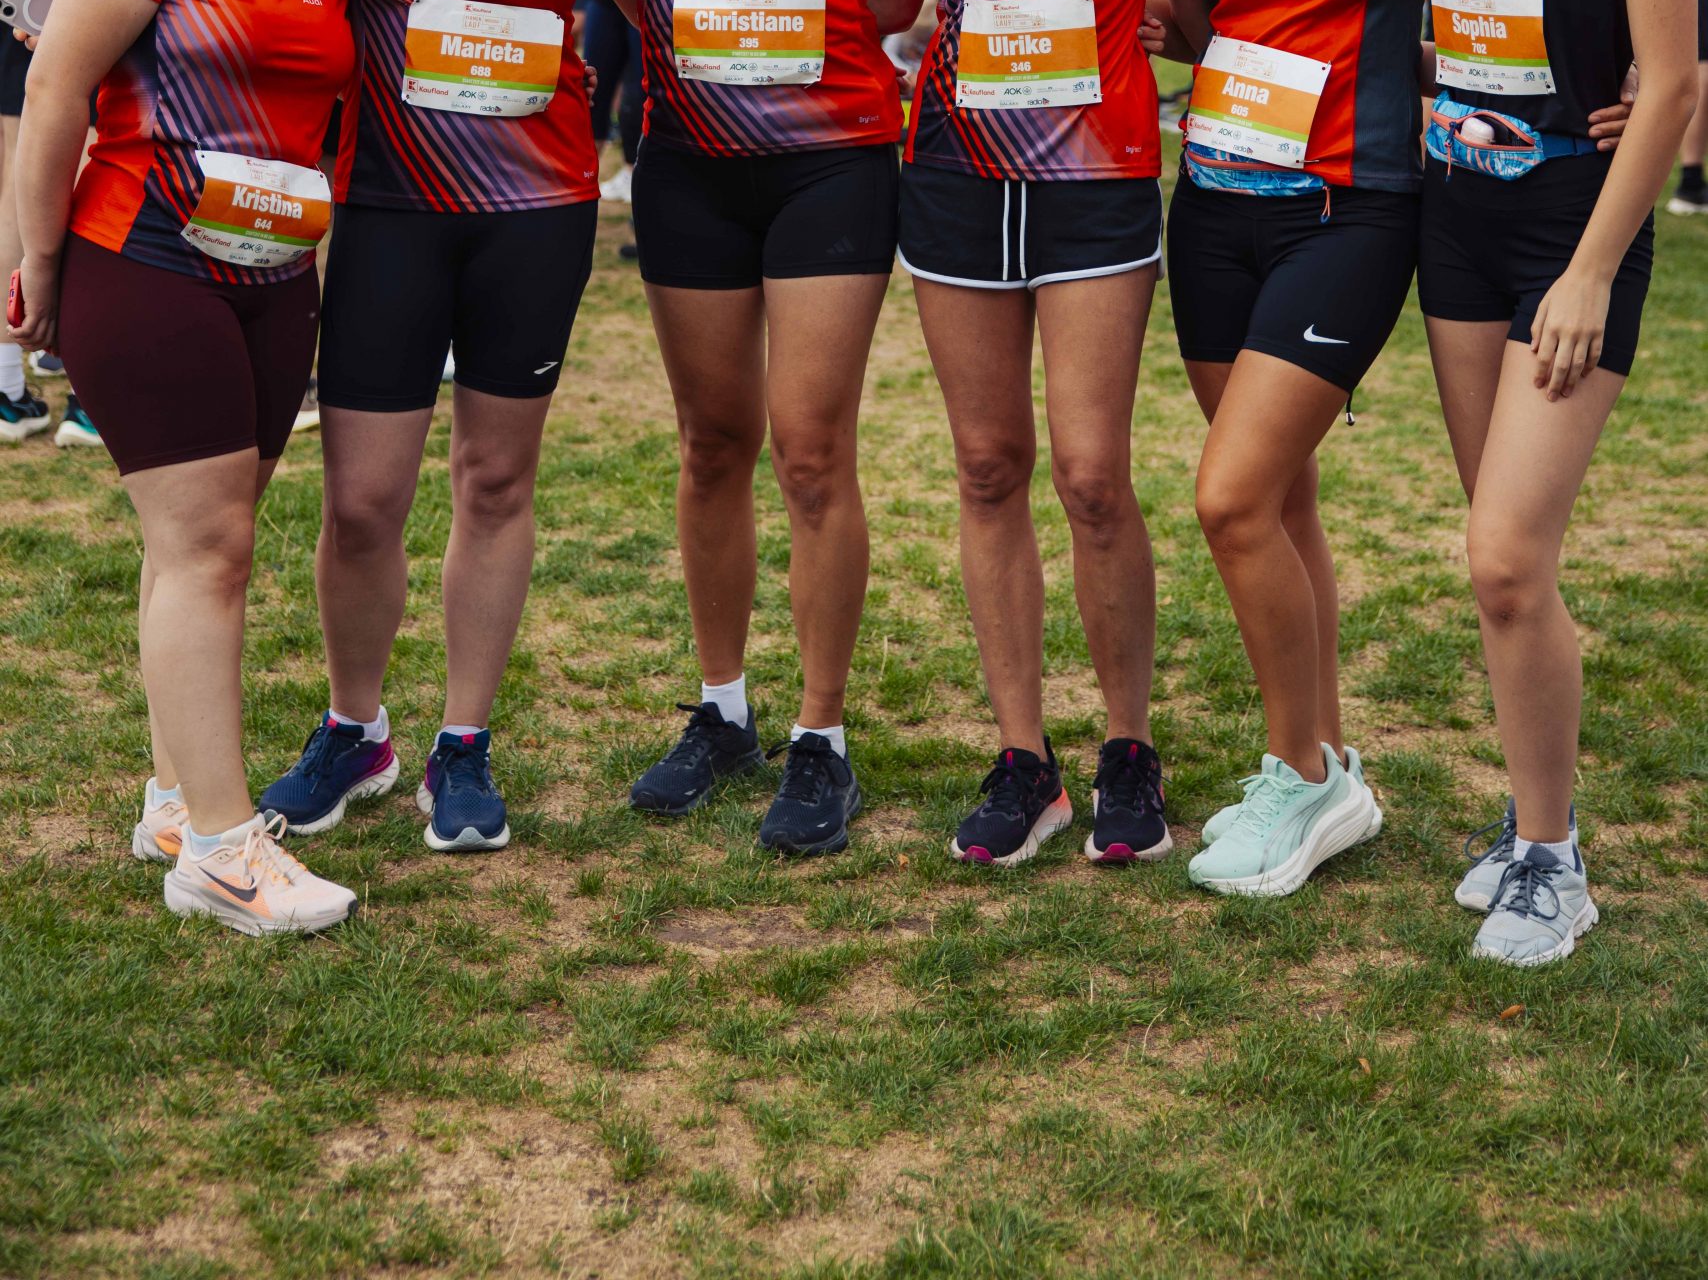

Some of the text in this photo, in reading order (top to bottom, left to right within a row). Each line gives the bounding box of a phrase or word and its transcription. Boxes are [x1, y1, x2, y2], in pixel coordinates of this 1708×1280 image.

[694, 10, 804, 32] Christiane
[1452, 12, 1507, 40] Sophia
[440, 35, 524, 64] Marieta
[739, 38, 759, 48] 395
[988, 35, 1052, 57] Ulrike
[1472, 42, 1487, 54] 702
[470, 65, 491, 78] 688
[1011, 62, 1031, 72] 346
[1469, 68, 1481, 77] AOK
[419, 86, 477, 99] Kaufland AOK
[1222, 75, 1270, 104] Anna
[1231, 104, 1249, 117] 605
[1218, 128, 1232, 137] AOK
[232, 184, 303, 219] Kristina
[254, 218, 272, 230] 644
[202, 234, 255, 251] Kaufland AOK
